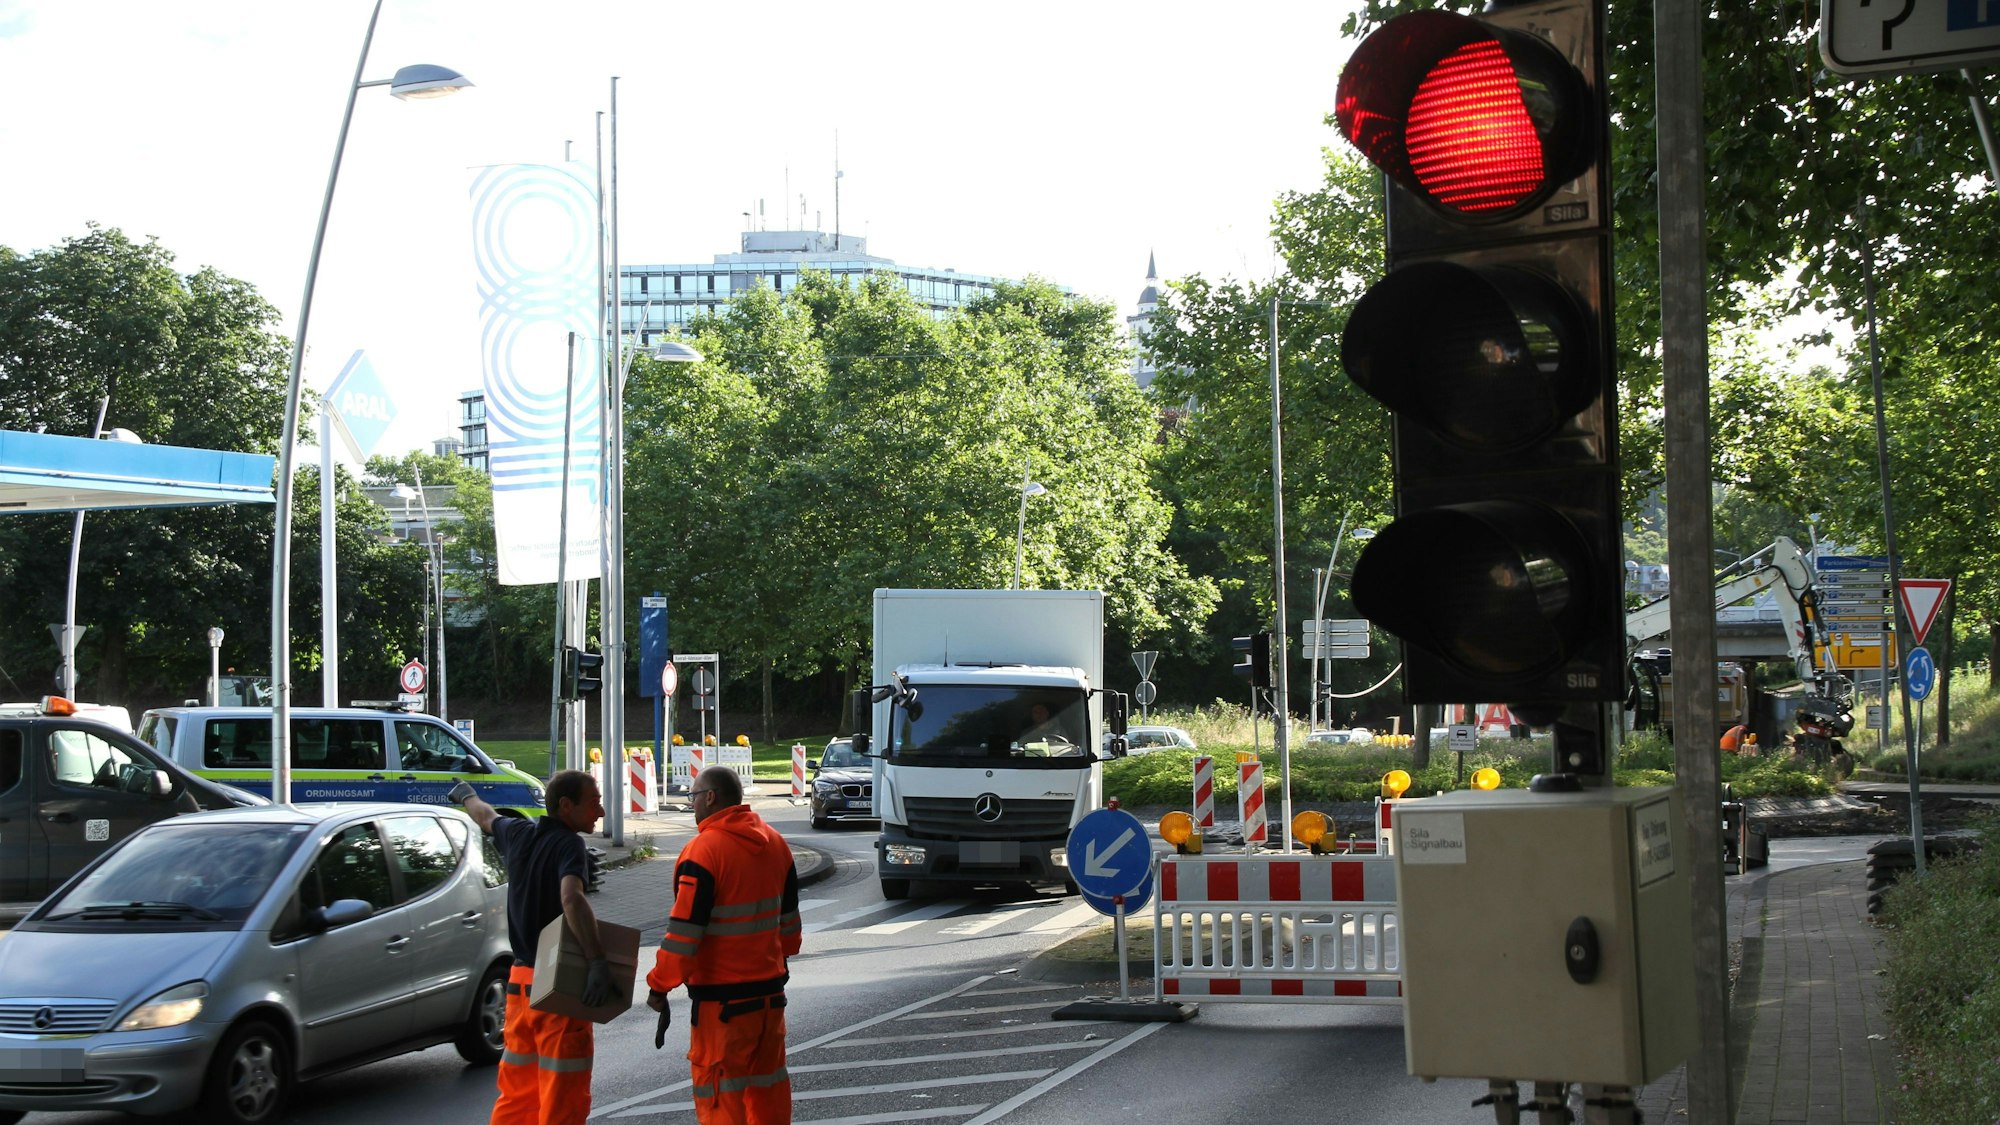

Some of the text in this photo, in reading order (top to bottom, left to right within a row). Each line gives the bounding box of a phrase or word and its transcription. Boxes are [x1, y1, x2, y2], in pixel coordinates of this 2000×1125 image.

[1551, 206, 1582, 221] Sila
[341, 390, 391, 422] ARAL
[1567, 673, 1597, 688] Sila
[305, 789, 376, 798] ORDNUNGSAMT
[1410, 828, 1430, 839] Sila
[1410, 839, 1463, 852] Signalbau
